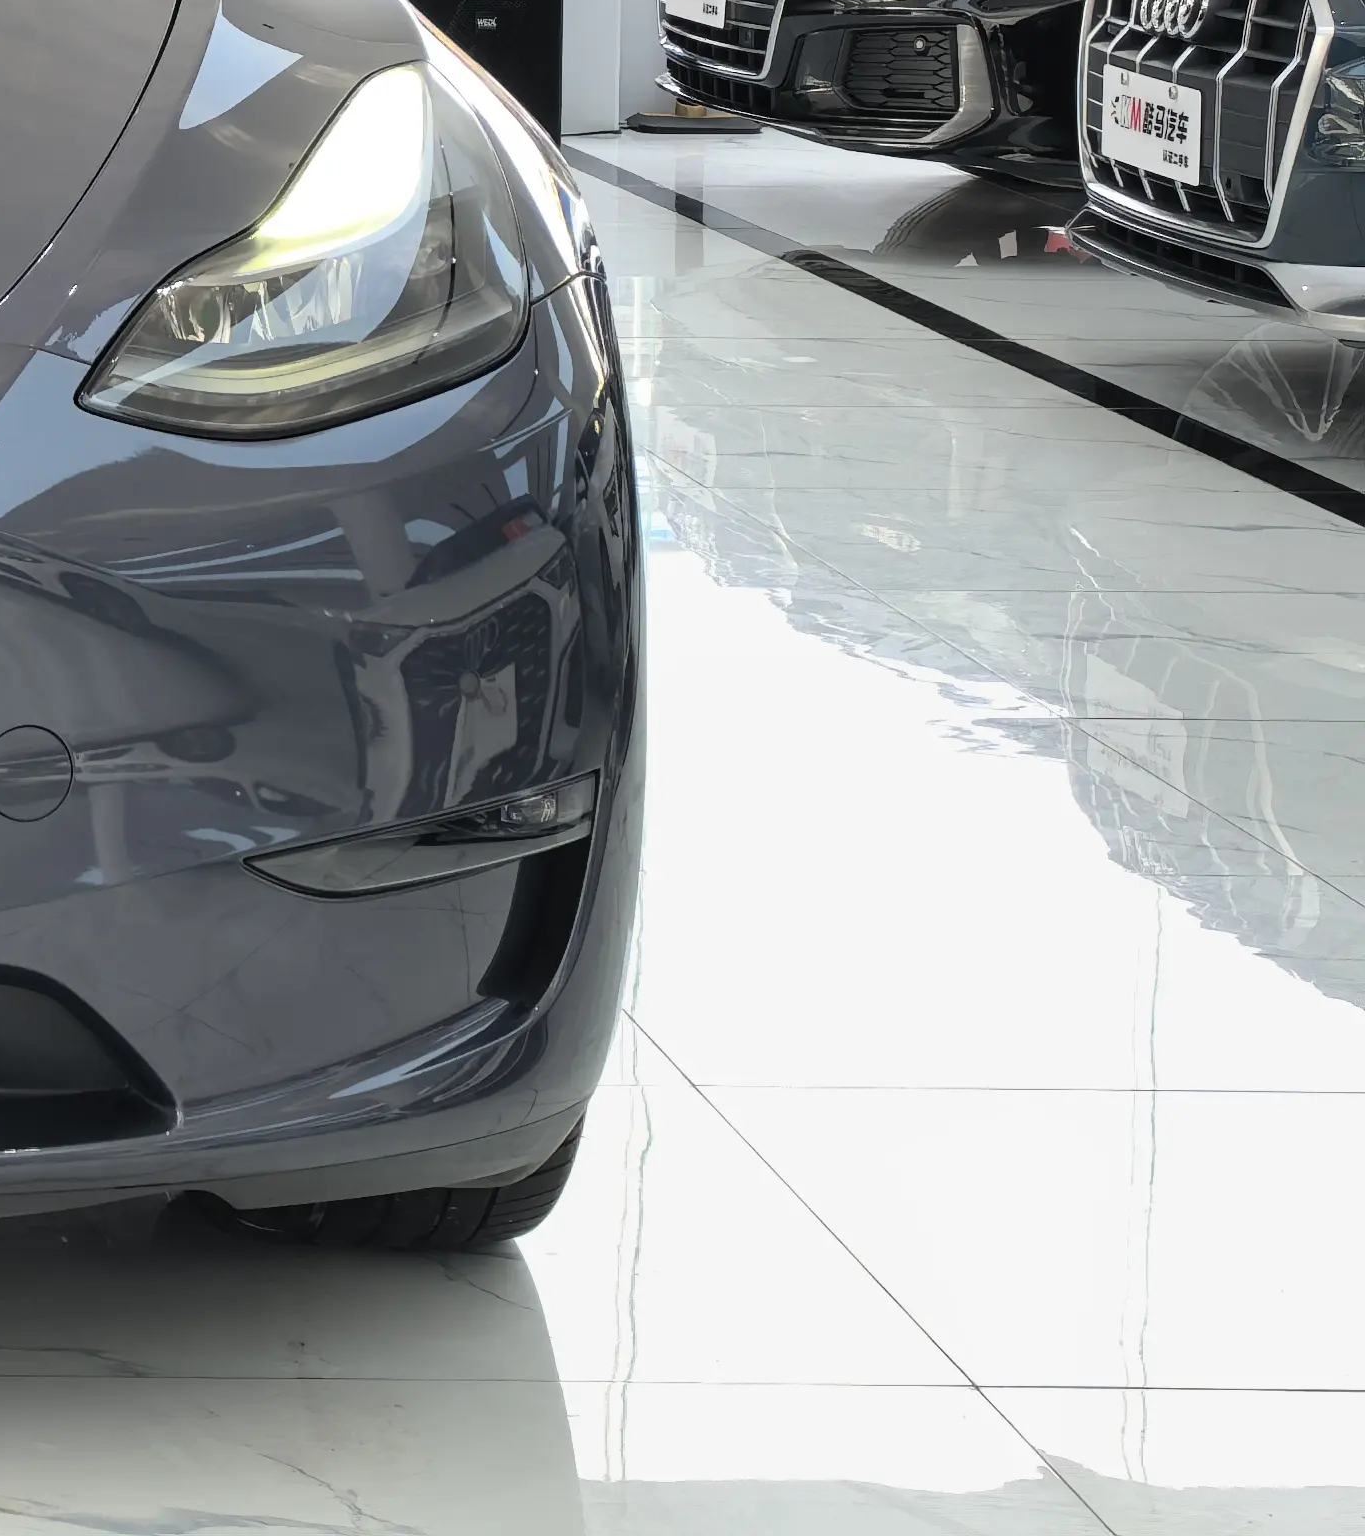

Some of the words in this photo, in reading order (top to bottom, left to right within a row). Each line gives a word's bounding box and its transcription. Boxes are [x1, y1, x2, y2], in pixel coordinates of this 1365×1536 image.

[1119, 94, 1143, 133] KM
[1142, 101, 1190, 145] 酷马汽车
